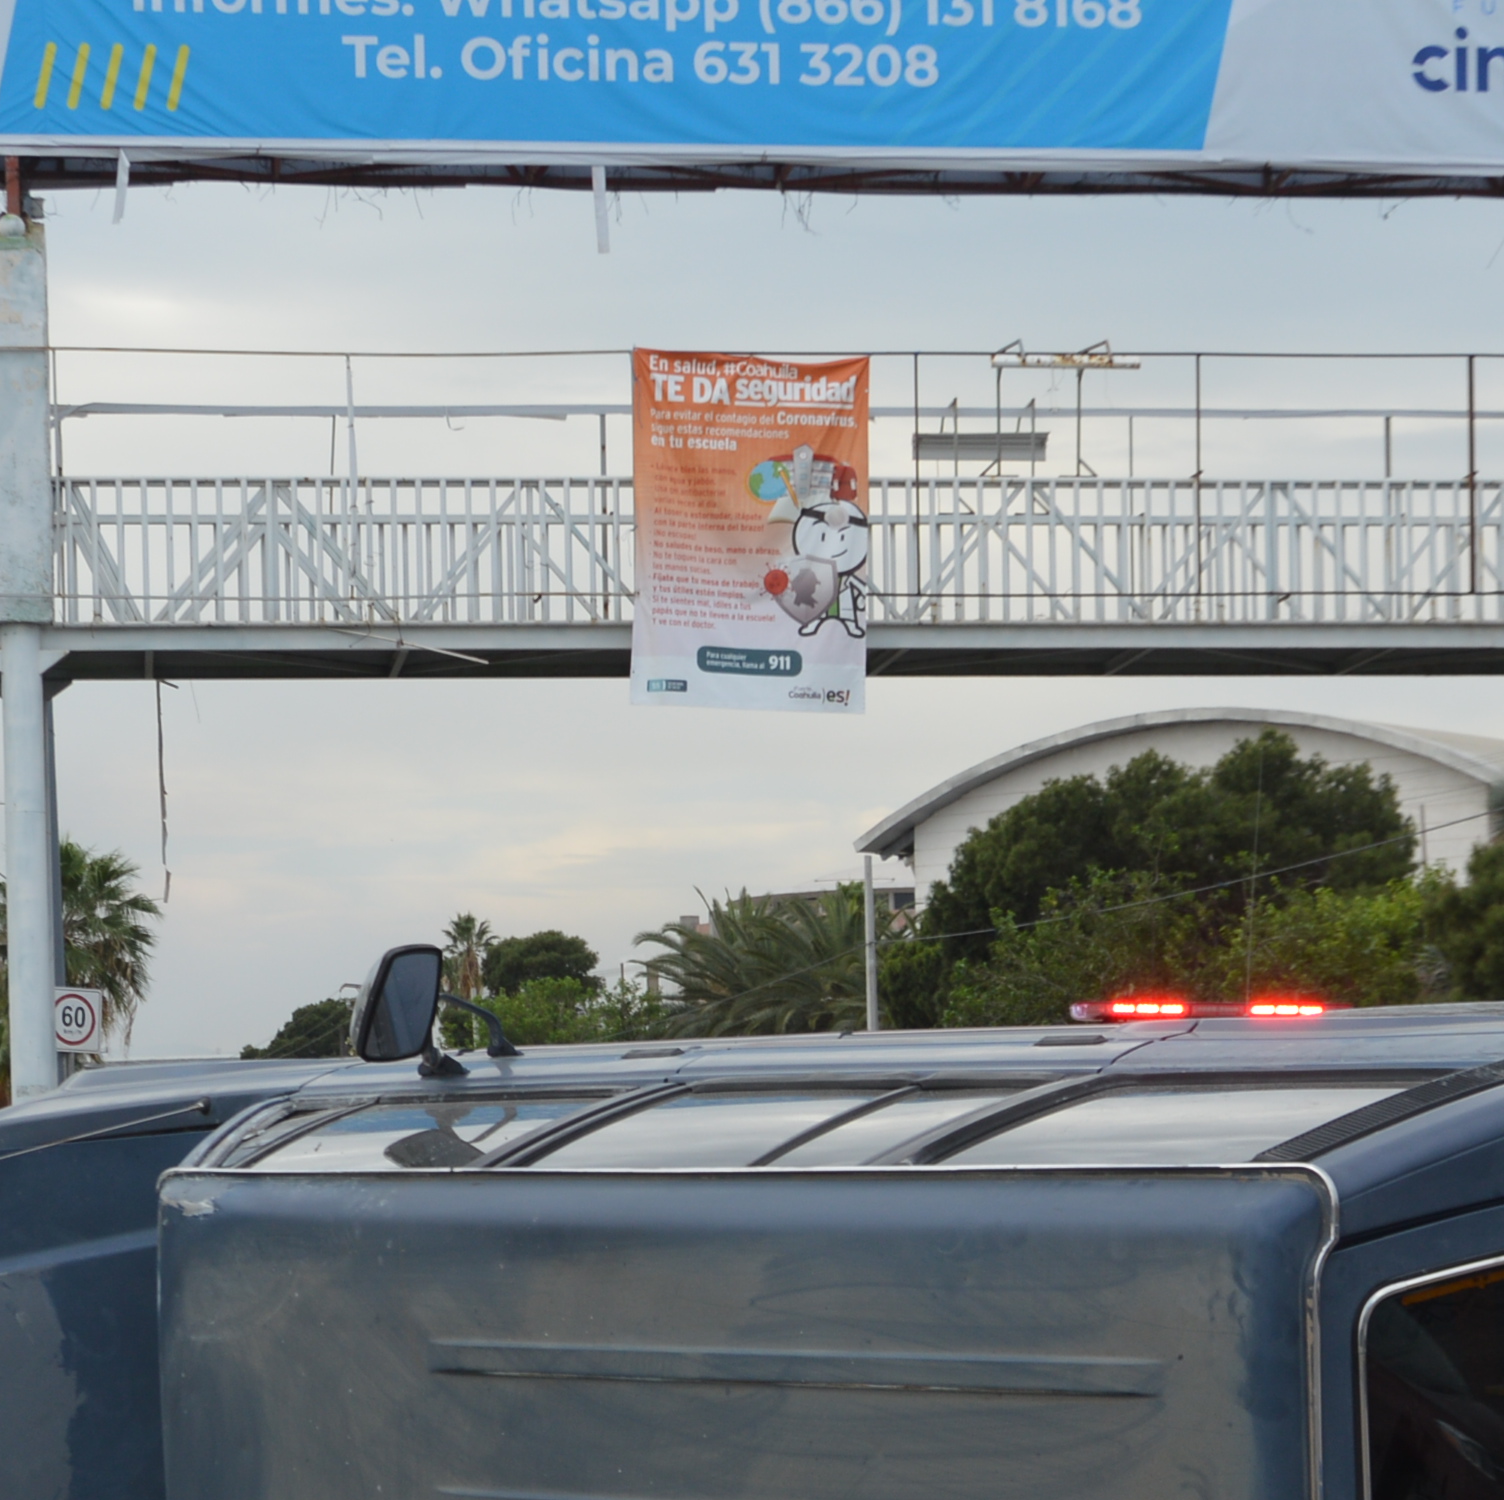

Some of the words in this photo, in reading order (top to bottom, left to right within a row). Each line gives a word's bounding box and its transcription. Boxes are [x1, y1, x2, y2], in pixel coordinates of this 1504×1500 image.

[927, 0, 994, 26] 131
[1014, 0, 1142, 28] 8168
[342, 34, 443, 79] Tel.
[460, 34, 674, 83] Oficina
[693, 41, 781, 84] 631
[799, 43, 939, 87] 3208
[650, 354, 668, 371] En
[674, 359, 721, 376] salud,
[724, 361, 799, 379] #Coahuila
[650, 373, 685, 402] TE
[693, 376, 731, 405] DA
[735, 374, 857, 407] seguridad
[650, 408, 671, 420] Para
[673, 411, 702, 421] evitar
[704, 411, 714, 422] el
[716, 413, 758, 426] contagio
[759, 414, 775, 425] del
[651, 434, 665, 447] en
[670, 435, 684, 448] tu
[687, 437, 738, 451] escuela
[677, 424, 704, 434] estas
[705, 426, 790, 439] recomendaciones
[768, 655, 791, 670] 911
[61, 1005, 86, 1028] 60
